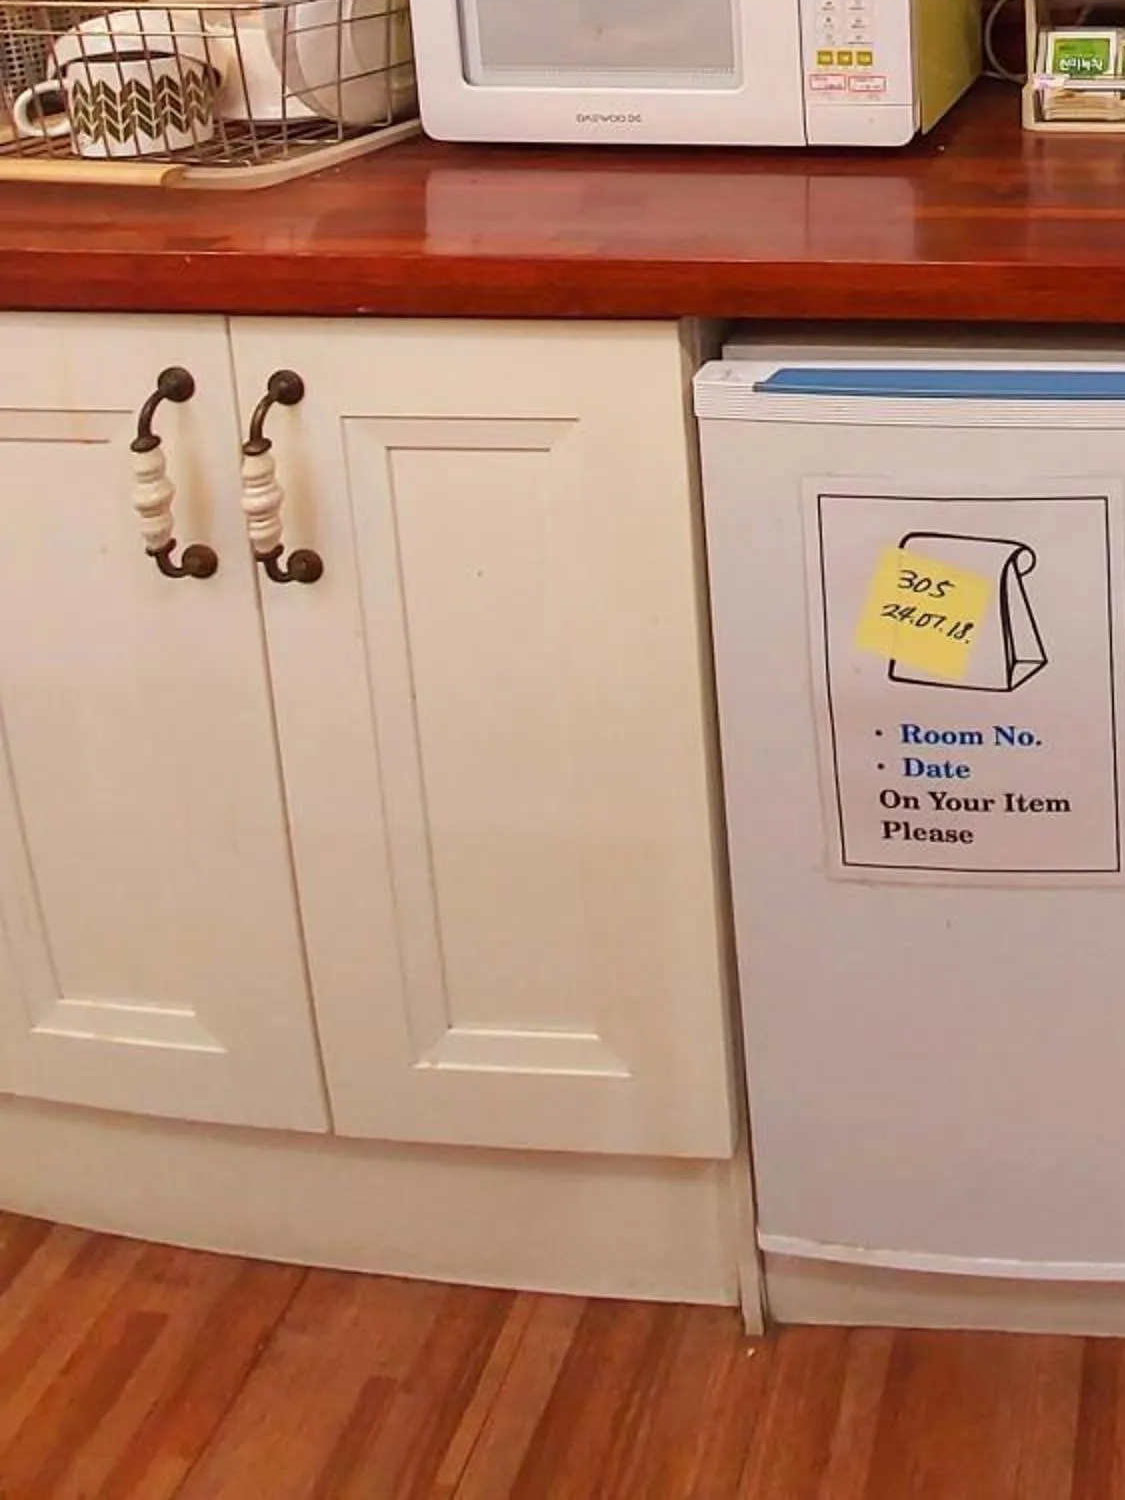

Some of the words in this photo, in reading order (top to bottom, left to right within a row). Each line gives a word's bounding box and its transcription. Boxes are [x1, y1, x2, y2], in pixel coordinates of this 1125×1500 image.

[899, 723, 983, 746] Room
[994, 725, 1043, 747] No.
[902, 758, 971, 779] Date
[879, 789, 921, 811] On
[928, 791, 995, 813] Your
[1003, 793, 1072, 813] Item
[882, 820, 974, 845] Please
